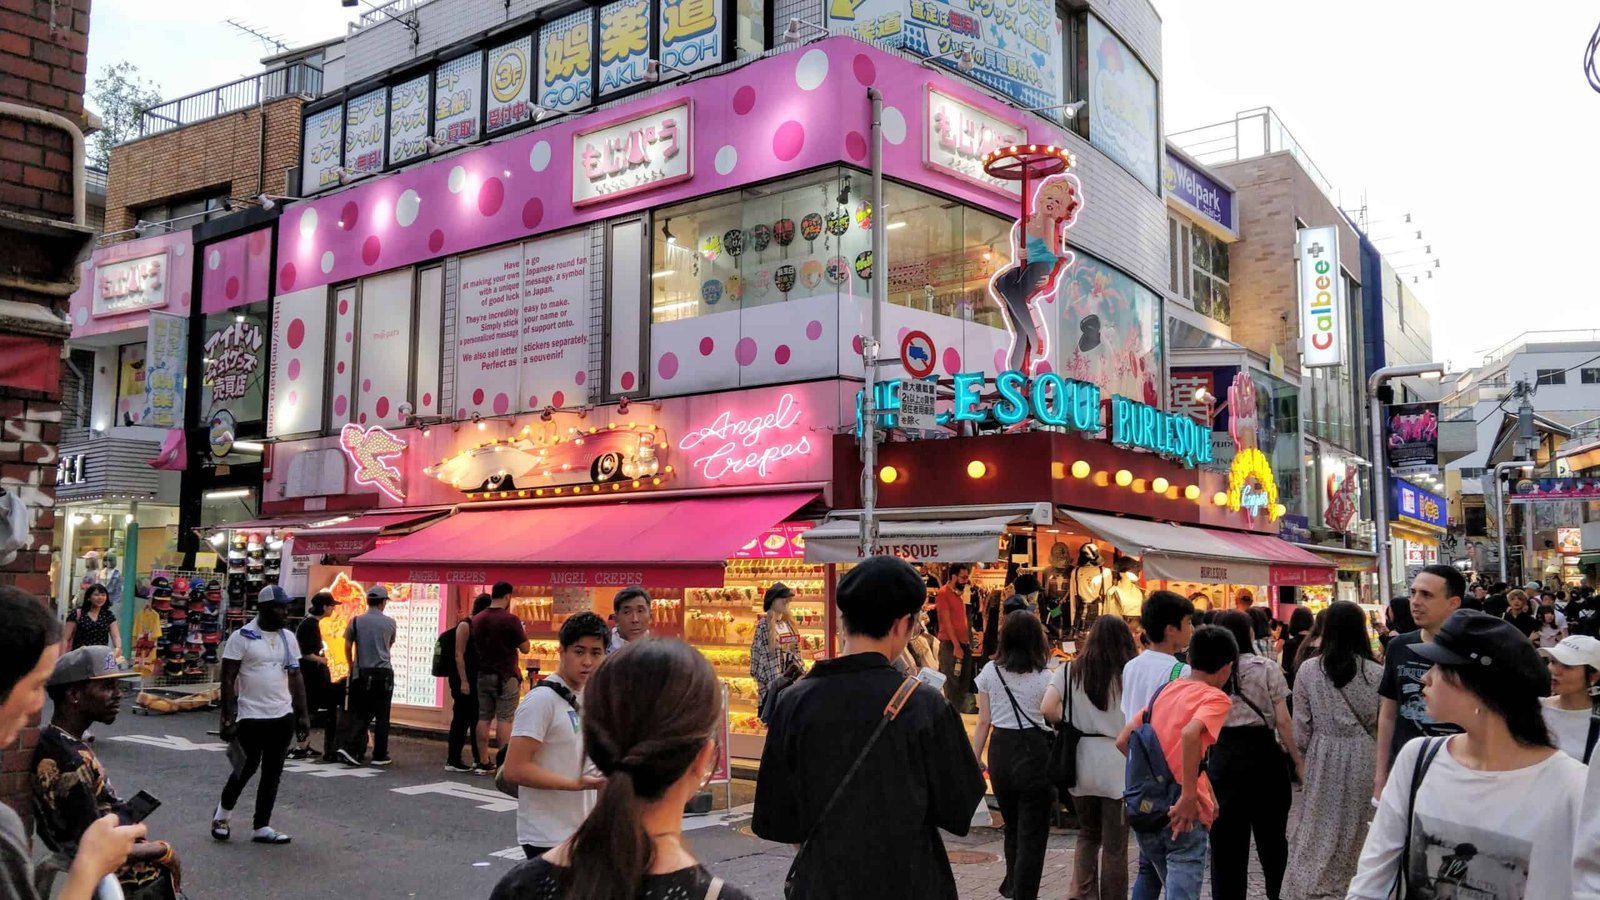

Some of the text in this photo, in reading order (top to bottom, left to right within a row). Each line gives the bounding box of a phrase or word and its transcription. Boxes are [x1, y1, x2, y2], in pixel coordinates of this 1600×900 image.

[545, 0, 718, 86] 娯楽道
[496, 63, 522, 90] 3F
[1175, 162, 1221, 212] Welpark
[470, 278, 492, 288] making
[493, 275, 506, 284] your
[507, 272, 520, 280] own
[525, 264, 555, 276] Japanese
[556, 257, 575, 269] round
[576, 256, 588, 265] fan
[504, 261, 520, 270] Have
[479, 287, 493, 296] with
[561, 267, 585, 281] symbol
[489, 295, 505, 306] good
[506, 292, 520, 301] luck
[489, 307, 519, 319] incredibly
[523, 305, 539, 313] easy
[540, 302, 548, 310] to
[481, 321, 501, 331] Simply
[503, 318, 519, 327] stick
[524, 315, 538, 325] your
[540, 311, 559, 320] name
[531, 321, 557, 333] support
[203, 322, 263, 359] アイドル
[463, 353, 473, 362] We
[473, 351, 487, 361] also
[488, 348, 499, 358] sell
[500, 346, 518, 355] letter
[523, 341, 550, 352] stickers
[481, 360, 507, 370] Perfect
[508, 359, 518, 367] as
[529, 349, 564, 363] souvenir!
[213, 373, 249, 402] 売買店
[679, 393, 802, 450] Angel
[1112, 393, 1214, 470] BURLESQUE
[694, 436, 811, 480] Crepes
[446, 571, 486, 583] CREPES
[550, 571, 643, 585] ANGEL CREPES
